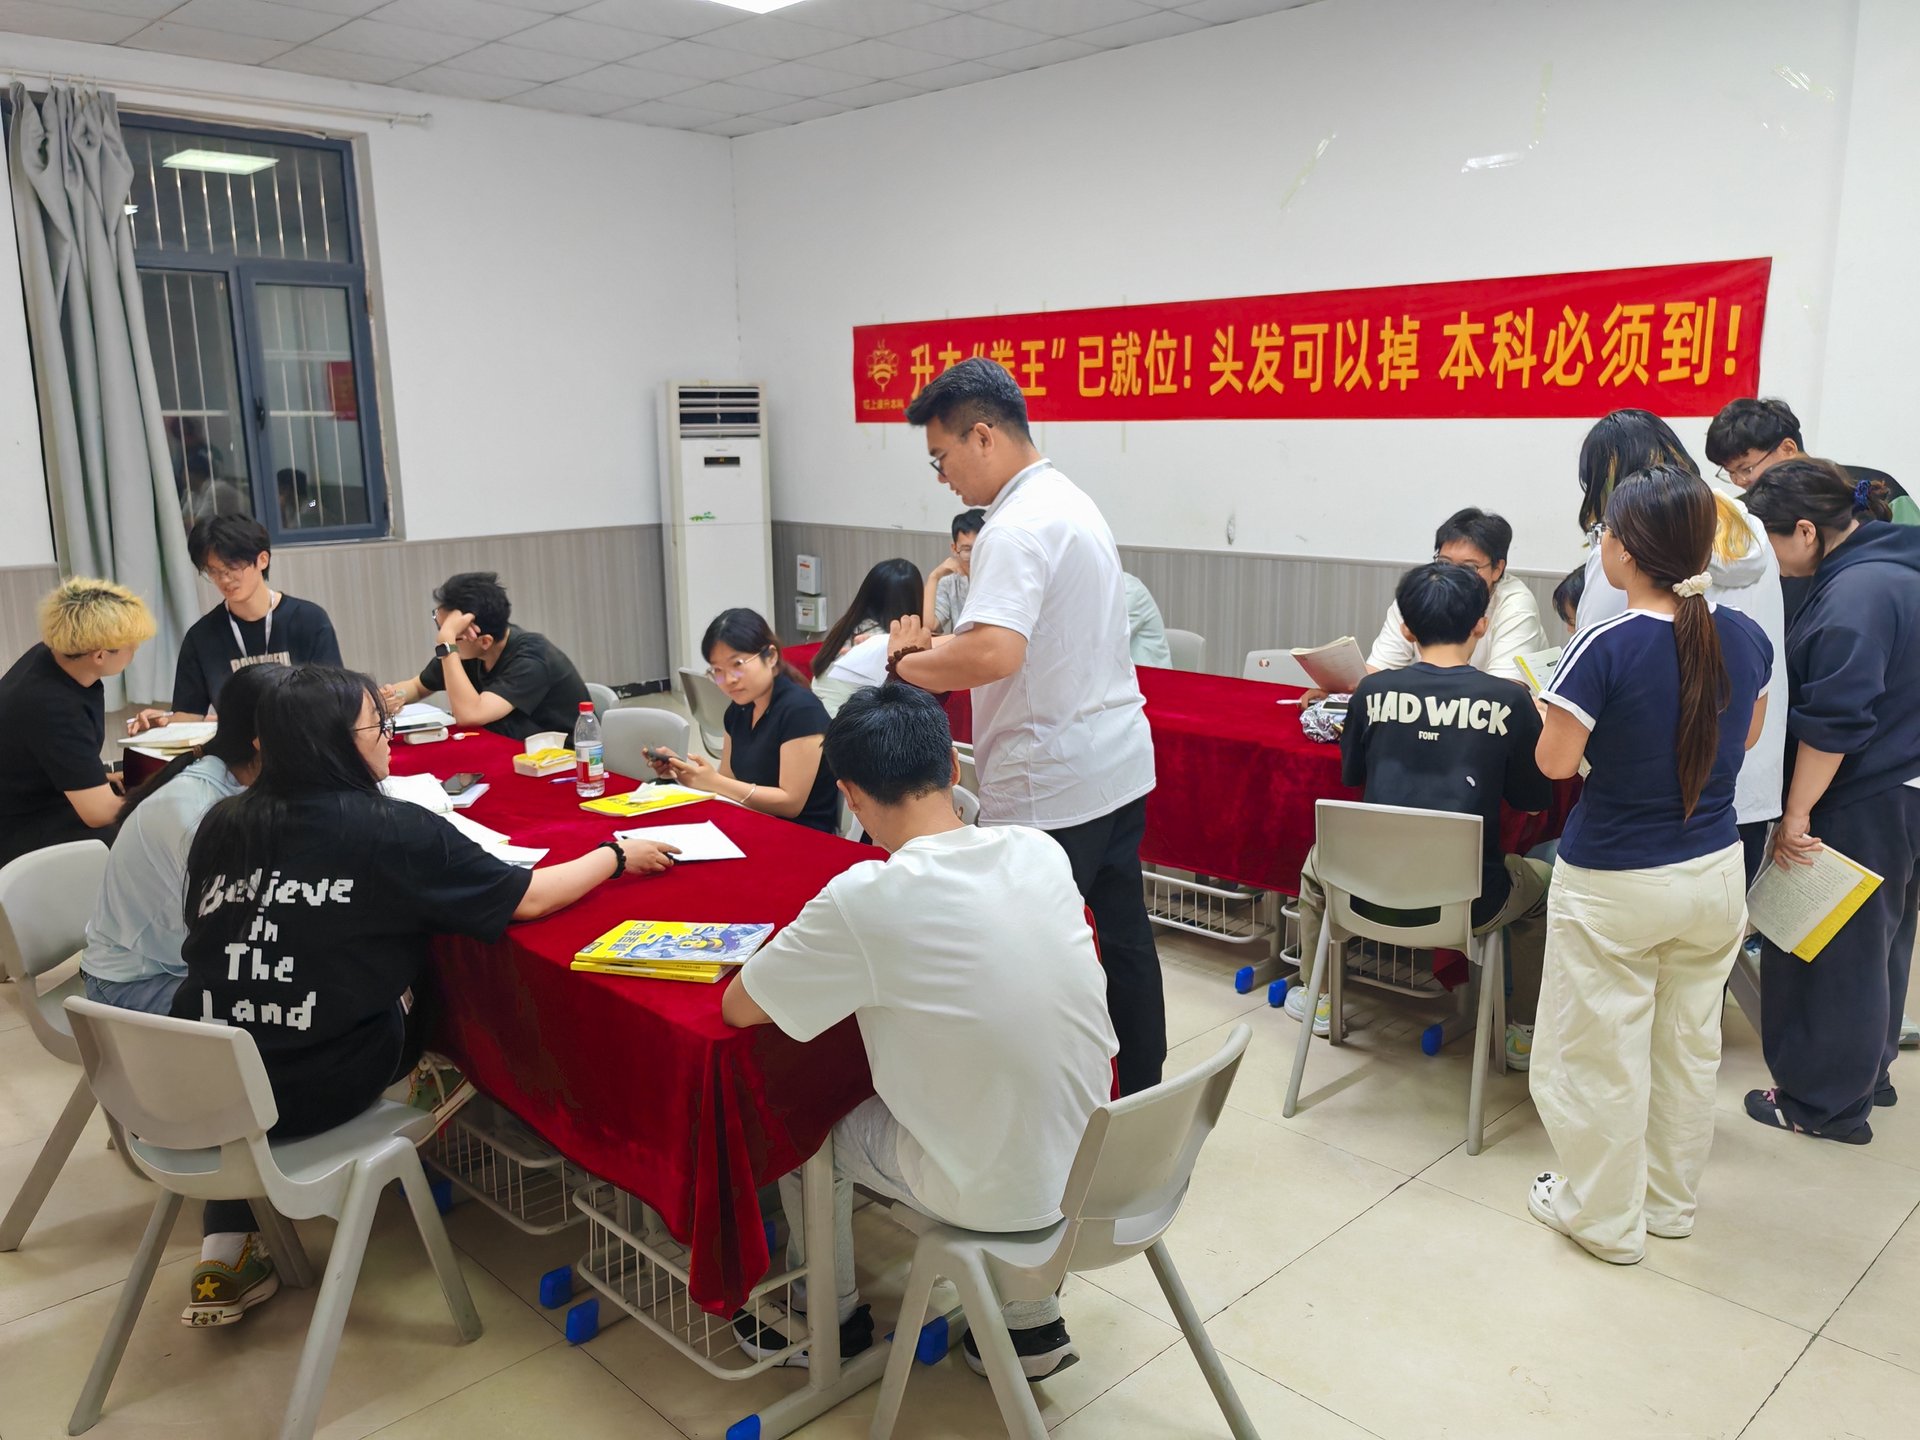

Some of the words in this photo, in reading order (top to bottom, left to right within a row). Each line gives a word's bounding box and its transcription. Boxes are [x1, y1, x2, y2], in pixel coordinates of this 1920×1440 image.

[1209, 314, 1420, 396] 头发可以掉
[1438, 297, 1742, 391] 本科必须到!
[1418, 730, 1440, 741] FONT
[248, 907, 279, 942] in
[224, 942, 294, 983] The
[200, 989, 317, 1031] Land
